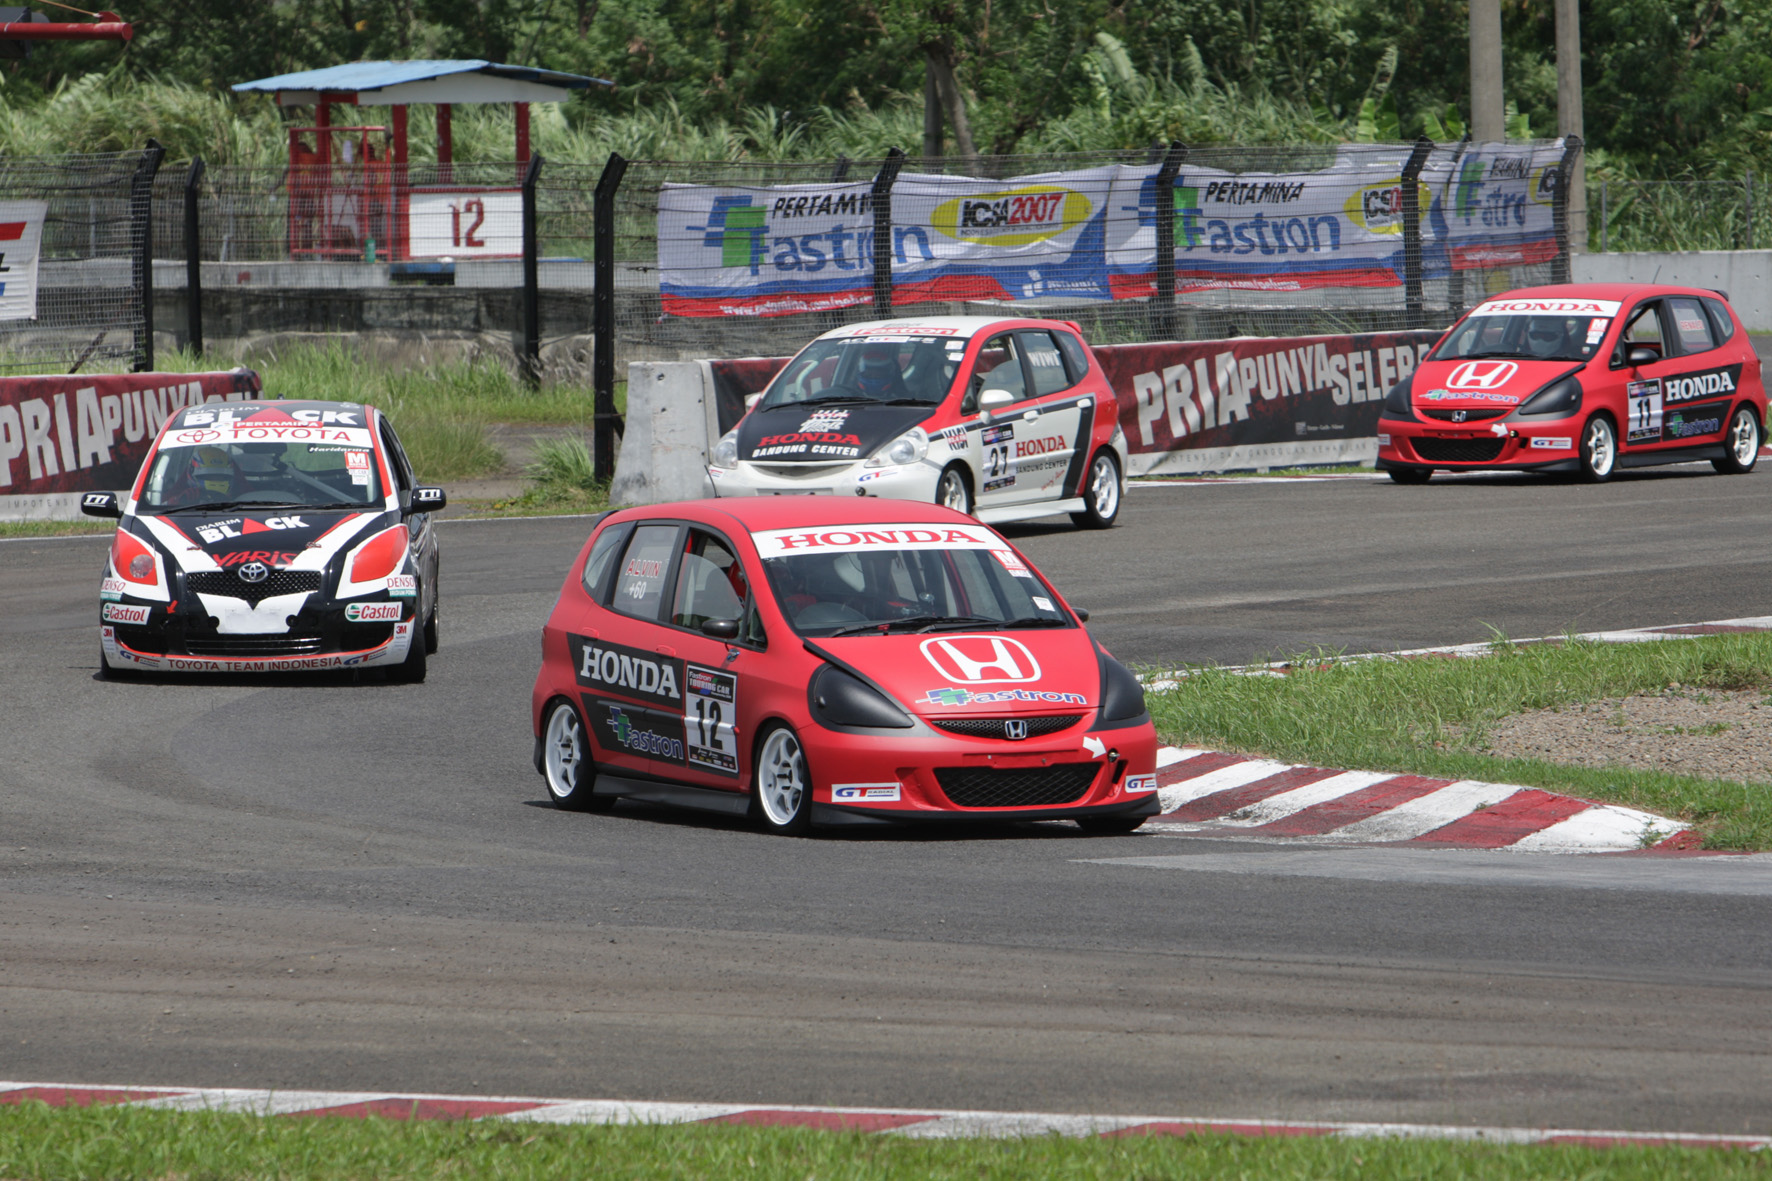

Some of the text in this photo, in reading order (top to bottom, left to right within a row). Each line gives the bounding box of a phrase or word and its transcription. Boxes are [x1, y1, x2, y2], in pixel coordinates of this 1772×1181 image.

[1204, 182, 1305, 205] PERTAMINA
[771, 193, 873, 219] PERTAMI
[449, 199, 484, 247] 12
[1173, 208, 1340, 256] Fastron
[1485, 302, 1605, 312] HONDA
[1133, 351, 1251, 446] PRIA
[1239, 343, 1334, 400] PUNYA
[1665, 371, 1736, 402] HONDA
[1433, 389, 1519, 404] Fastron
[1637, 398, 1652, 428] 11
[0, 386, 111, 488] PRIA
[228, 428, 351, 441] TOYOTA
[757, 432, 862, 447] HONDA
[752, 444, 859, 458] BANDUNG CENTER
[1015, 435, 1067, 457] HONDA
[990, 446, 1009, 477] 27
[85, 495, 110, 504] TTI
[419, 489, 441, 499] TTI
[775, 529, 986, 549] HONDA
[625, 559, 662, 578] ALVIN
[387, 577, 416, 588] DENSO
[109, 606, 145, 622] Castrol
[361, 604, 399, 619] Castrol
[396, 625, 407, 635] 3M
[168, 660, 219, 670] TOYOTA
[226, 661, 264, 671] TEAM
[268, 657, 342, 670] INDONESIA
[580, 645, 680, 699] HONDA
[689, 671, 712, 682] Fastron
[716, 684, 731, 695] CAR
[955, 688, 1088, 706] Fastron
[695, 698, 724, 751] 12
[619, 723, 684, 760] Fastron
